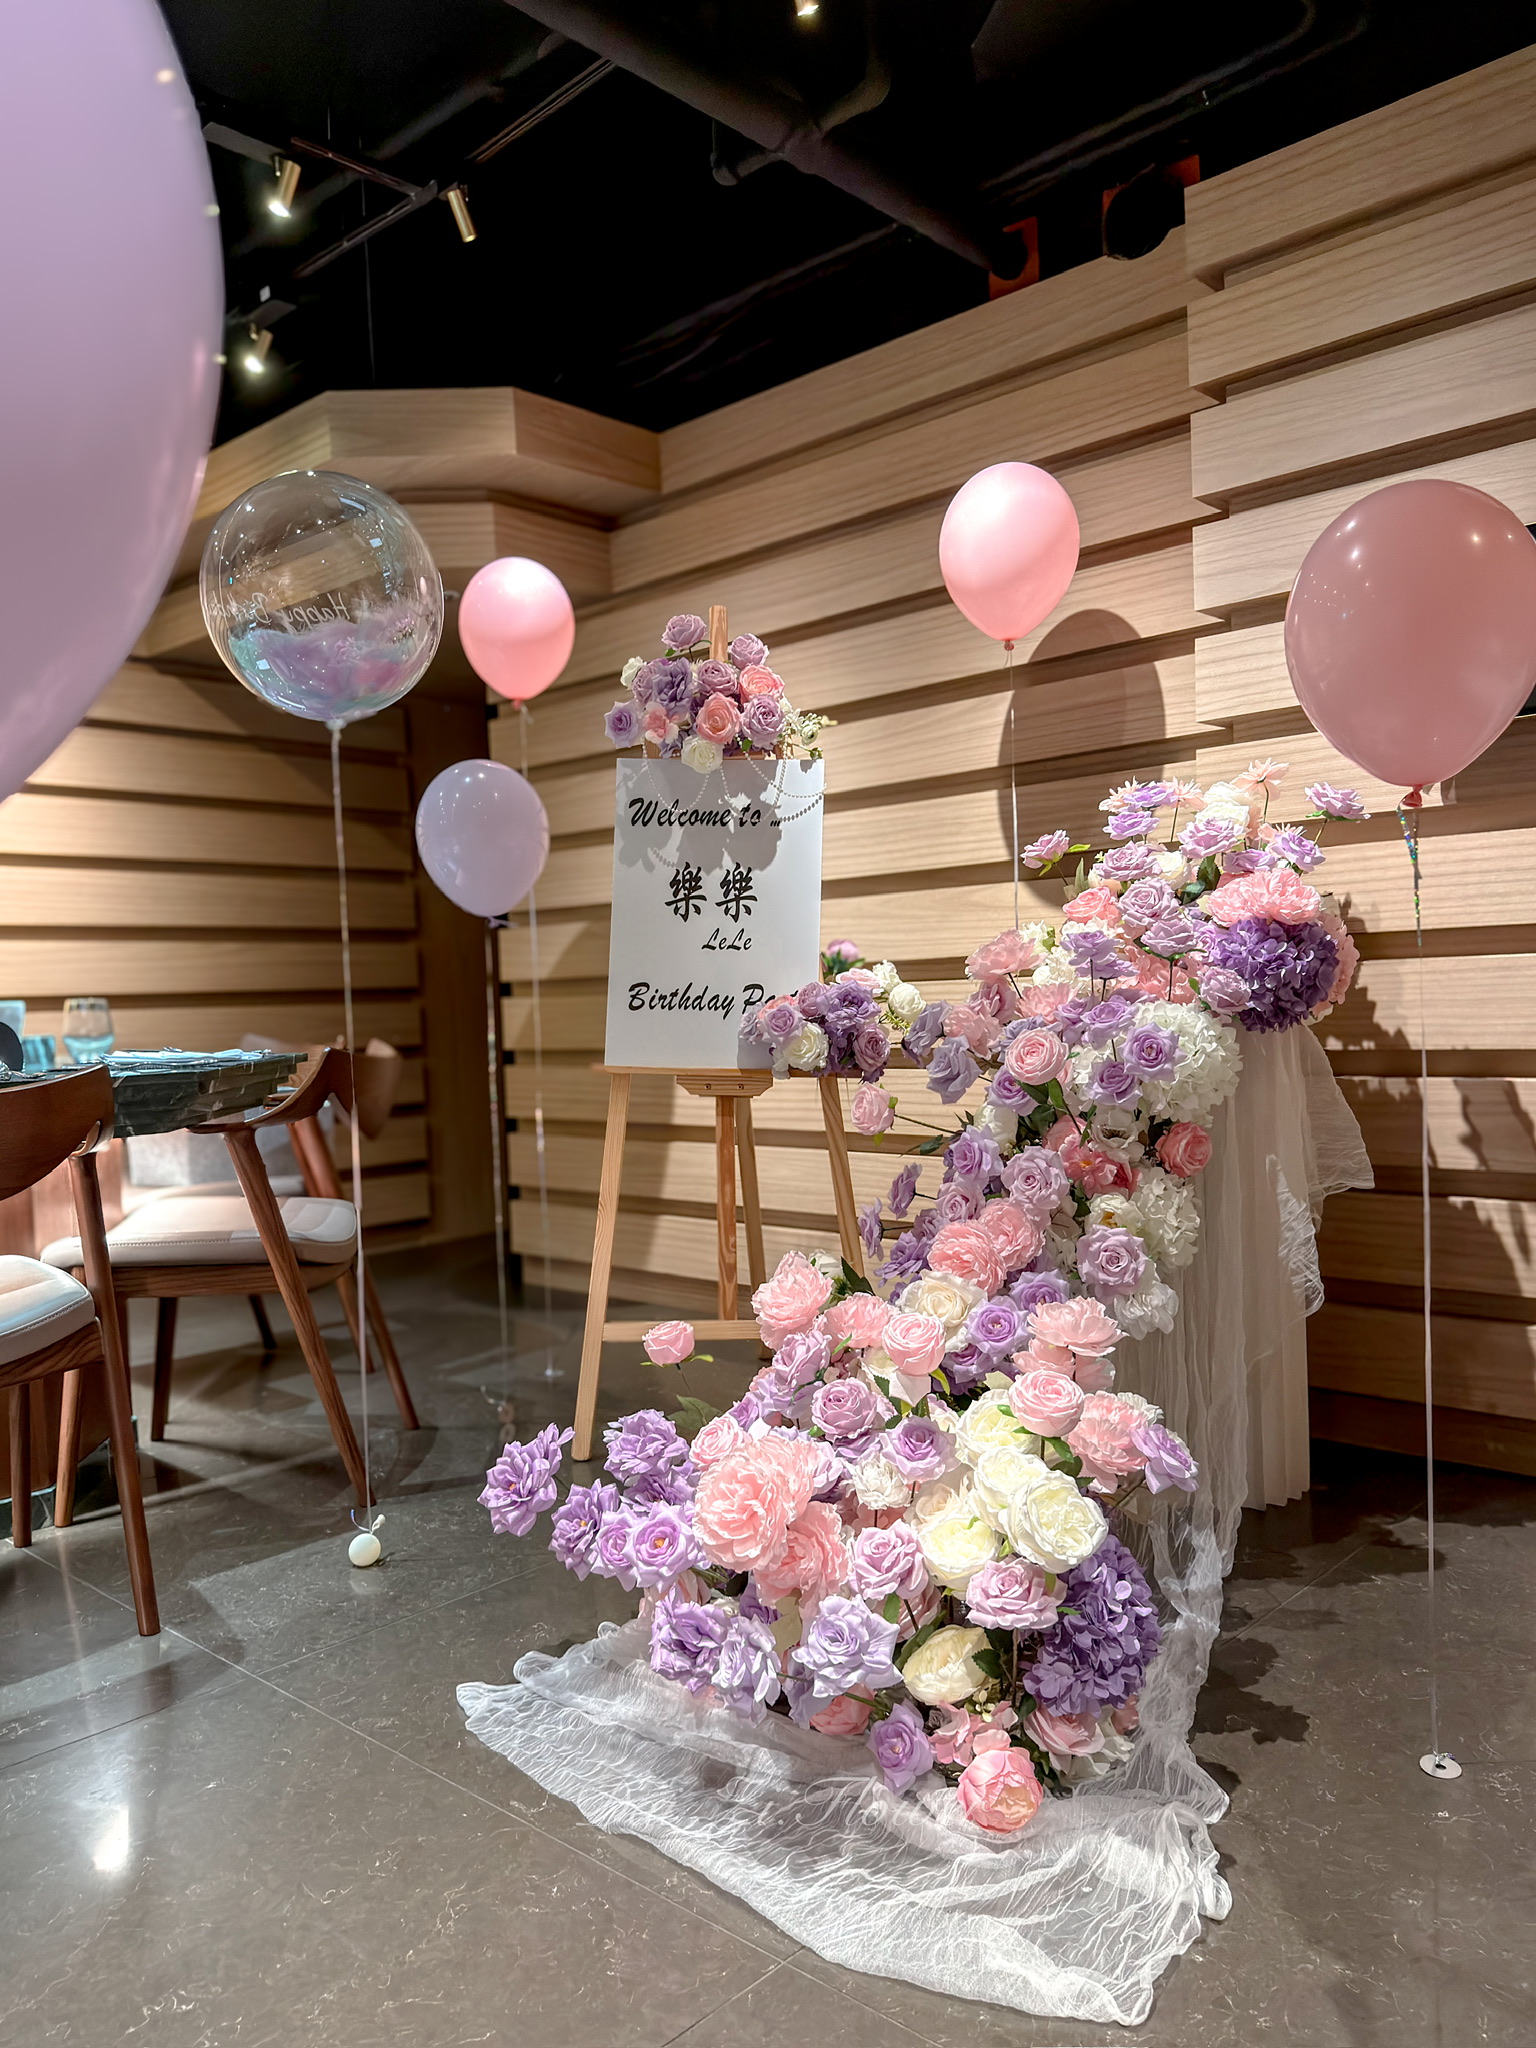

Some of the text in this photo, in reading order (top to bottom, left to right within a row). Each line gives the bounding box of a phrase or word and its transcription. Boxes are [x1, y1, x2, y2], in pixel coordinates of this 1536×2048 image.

[628, 797, 731, 828] Welcome
[738, 802, 762, 828] to
[664, 861, 758, 923] 樂樂
[701, 927, 752, 951] LeLe
[628, 981, 735, 1020] Birthday
